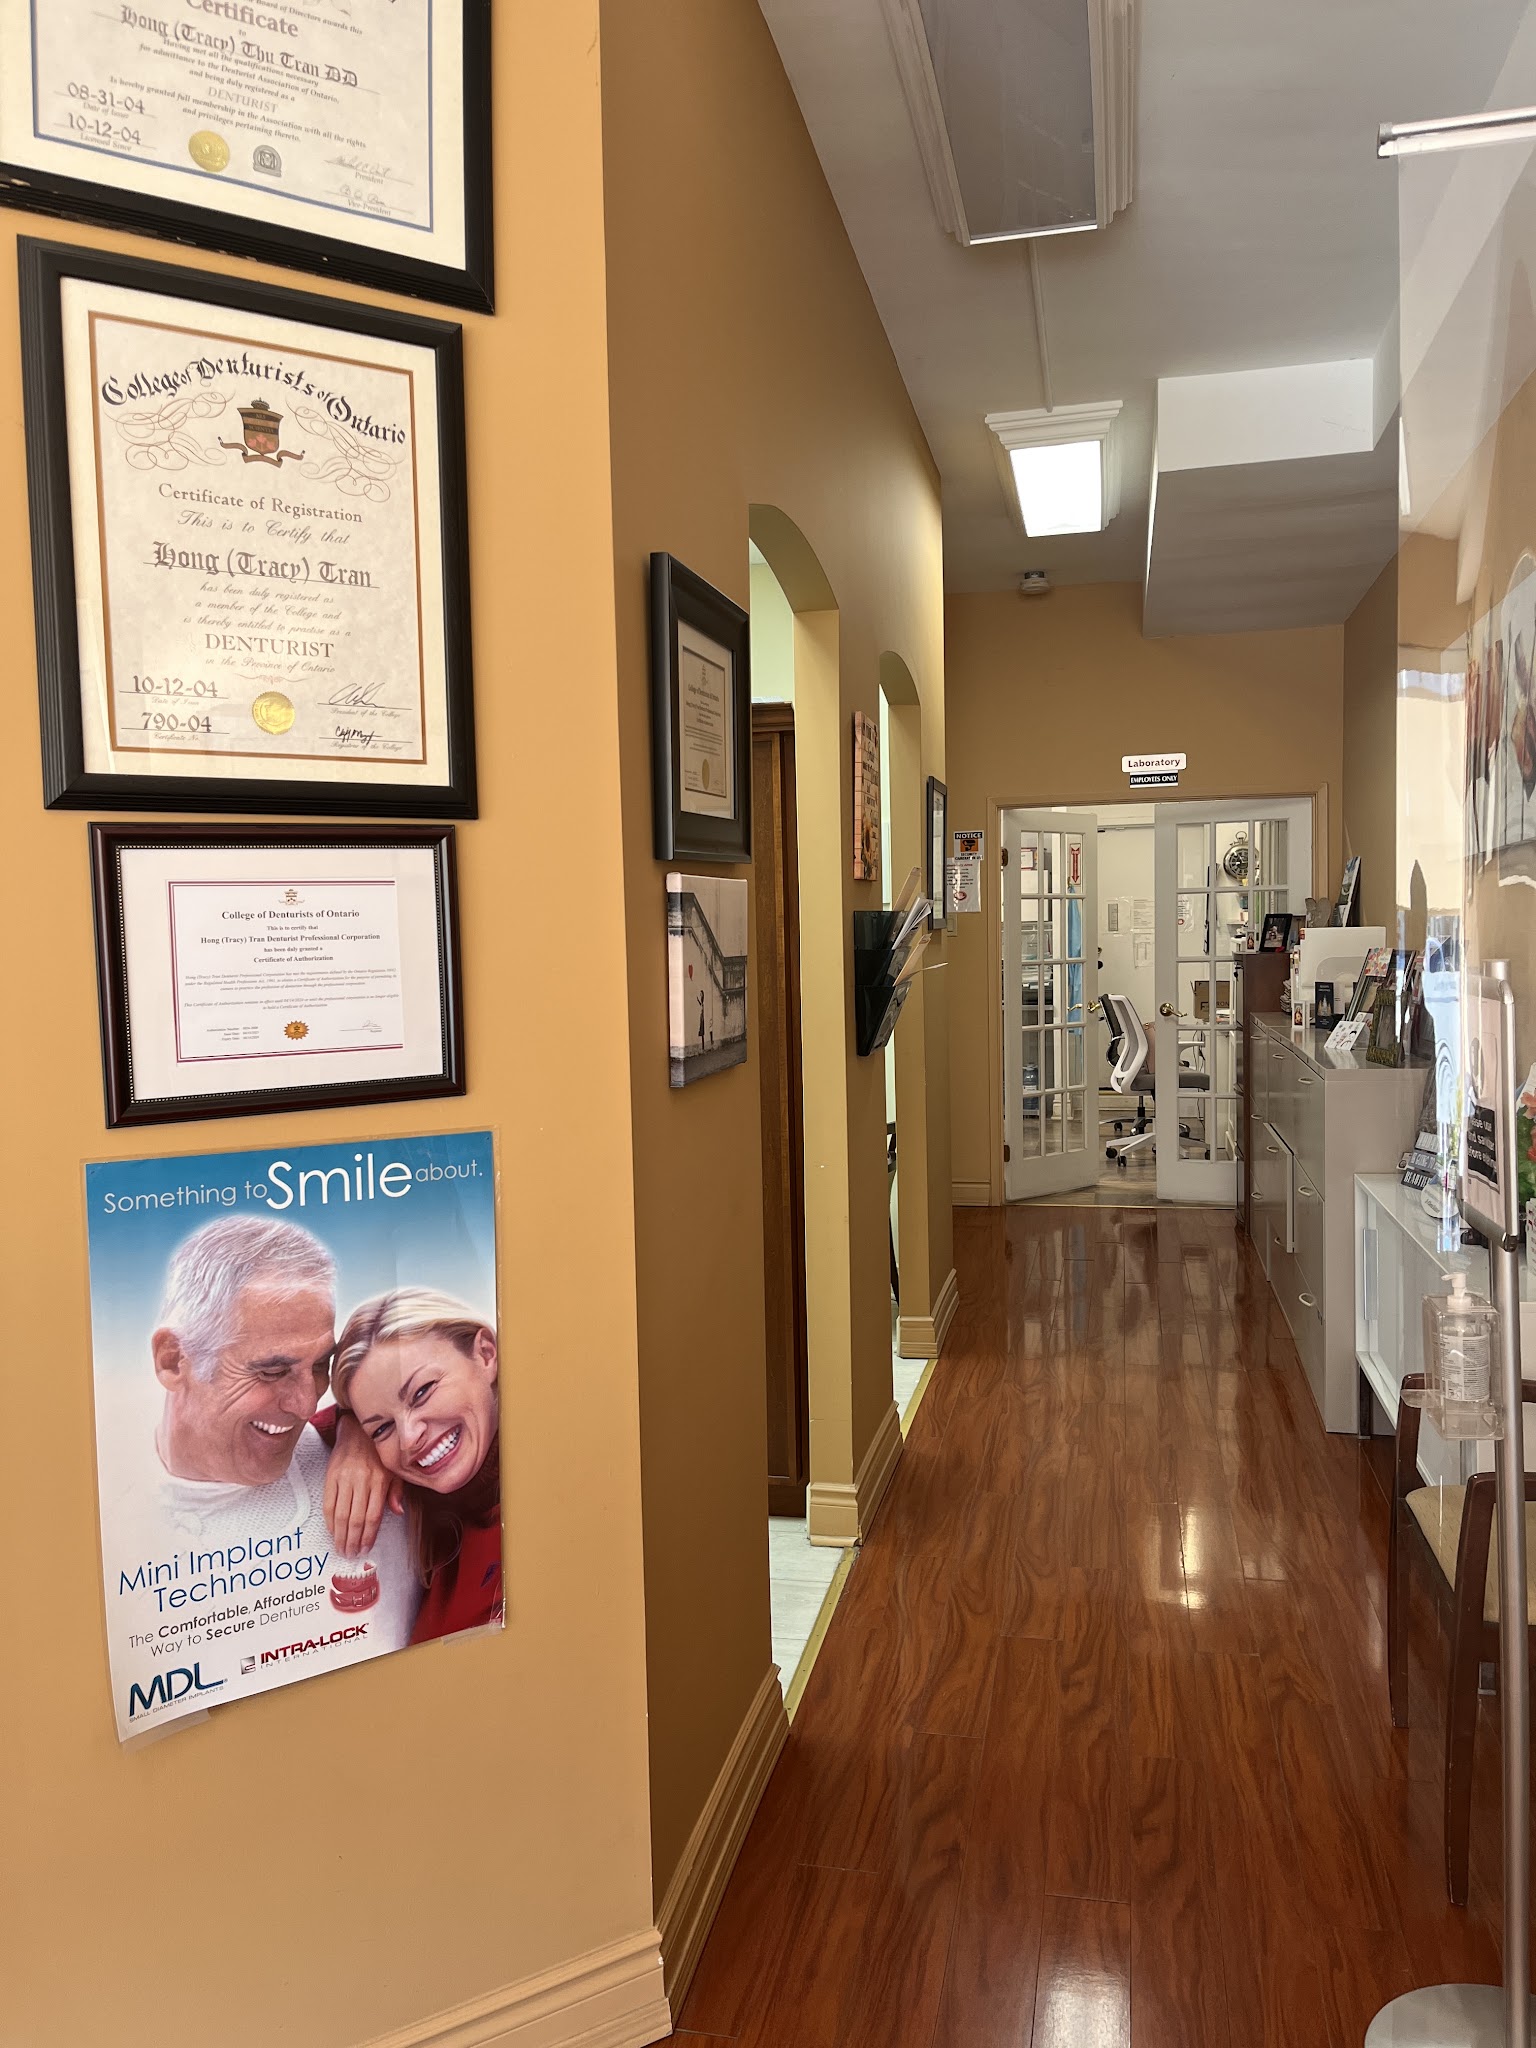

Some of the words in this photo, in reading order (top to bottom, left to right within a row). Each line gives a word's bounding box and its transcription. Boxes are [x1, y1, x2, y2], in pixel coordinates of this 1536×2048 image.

[289, 7, 321, 21] Directors
[322, 19, 348, 30] awards
[350, 26, 363, 35] this
[121, 5, 169, 37] Hong
[174, 21, 235, 54] (Tracy)
[241, 41, 274, 64] Thu
[280, 52, 319, 77] Tran
[153, 48, 195, 64] admittance
[208, 62, 219, 71] the
[221, 65, 255, 79] Denturist
[258, 74, 299, 91] Association
[302, 87, 309, 95] of
[311, 89, 339, 104] Ontario,
[163, 39, 191, 52] Having
[193, 47, 206, 55] met
[209, 50, 218, 59] all
[221, 53, 232, 62] the
[235, 58, 283, 76] qualifications
[286, 72, 319, 87] necessary
[68, 82, 145, 115] 08-31-04
[189, 69, 203, 77] and
[205, 72, 224, 84] being
[227, 77, 242, 89] duly
[244, 84, 279, 98] registered
[208, 87, 278, 113] DENTURIST
[120, 78, 144, 91] hereby
[147, 87, 175, 98] granted
[177, 92, 190, 101] full
[193, 98, 235, 115] membership
[247, 111, 258, 119] the
[260, 115, 303, 131] Association
[304, 127, 321, 136] with
[334, 134, 345, 142] the
[183, 107, 196, 115] and
[198, 111, 233, 125] privileges
[235, 121, 272, 136] pertaining
[68, 112, 141, 145] 10-12-04
[355, 172, 384, 185] President
[348, 199, 391, 216] Vice-President
[102, 373, 182, 406] College
[197, 352, 316, 396] Denturists
[317, 390, 332, 402] of
[326, 395, 406, 445] Ontario
[158, 483, 244, 507] Certificate
[250, 497, 265, 510] of
[272, 498, 363, 523] Registration
[177, 510, 213, 528] This
[222, 519, 233, 530] is
[242, 521, 255, 532] to
[265, 520, 312, 544] Certify
[321, 529, 350, 544] that
[153, 541, 220, 575] Hong
[227, 548, 310, 584] (Tracy)
[319, 561, 372, 588] Tran
[200, 582, 218, 593] has
[224, 584, 243, 594] been
[249, 588, 270, 599] duly
[275, 592, 320, 604] registered
[323, 596, 334, 604] as
[198, 615, 231, 628] thereby
[238, 621, 272, 631] entitled
[208, 602, 244, 611] member
[250, 604, 260, 615] of
[264, 606, 278, 614] the
[285, 604, 318, 618] College
[322, 612, 342, 620] and
[205, 633, 334, 658] DENTURIST
[221, 656, 236, 666] the
[241, 657, 282, 670] Province
[287, 663, 297, 673] of
[301, 662, 335, 673] Ontario
[133, 676, 218, 698] 10-12-04
[141, 712, 212, 733] 790-04
[1128, 759, 1180, 767] Laboratory
[222, 911, 255, 921] College
[257, 911, 267, 919] of
[269, 910, 313, 919] Denturists
[316, 910, 325, 918] of
[326, 910, 360, 918] Ontario
[221, 936, 247, 944] (Tracy)
[104, 1183, 236, 1214] Something
[244, 1180, 267, 1200] to
[266, 1153, 413, 1210] Smile
[415, 1159, 483, 1182] about.
[119, 1554, 178, 1595] Mini
[190, 1526, 303, 1573] Implant
[154, 1552, 329, 1612] Technology
[129, 1633, 154, 1648] The
[158, 1604, 251, 1638] Comfortable,
[253, 1584, 326, 1612] Affordable
[151, 1636, 183, 1657] Way
[187, 1633, 201, 1646] to
[206, 1618, 255, 1641] Secure
[260, 1601, 320, 1625] Dentures
[260, 1623, 368, 1665] INTRA-LOCK
[260, 1635, 368, 1669] INTERNATIONAL
[129, 1711, 151, 1723] SMALL
[152, 1696, 187, 1713] DIAMETER
[188, 1686, 224, 1701] IMPLANTS
